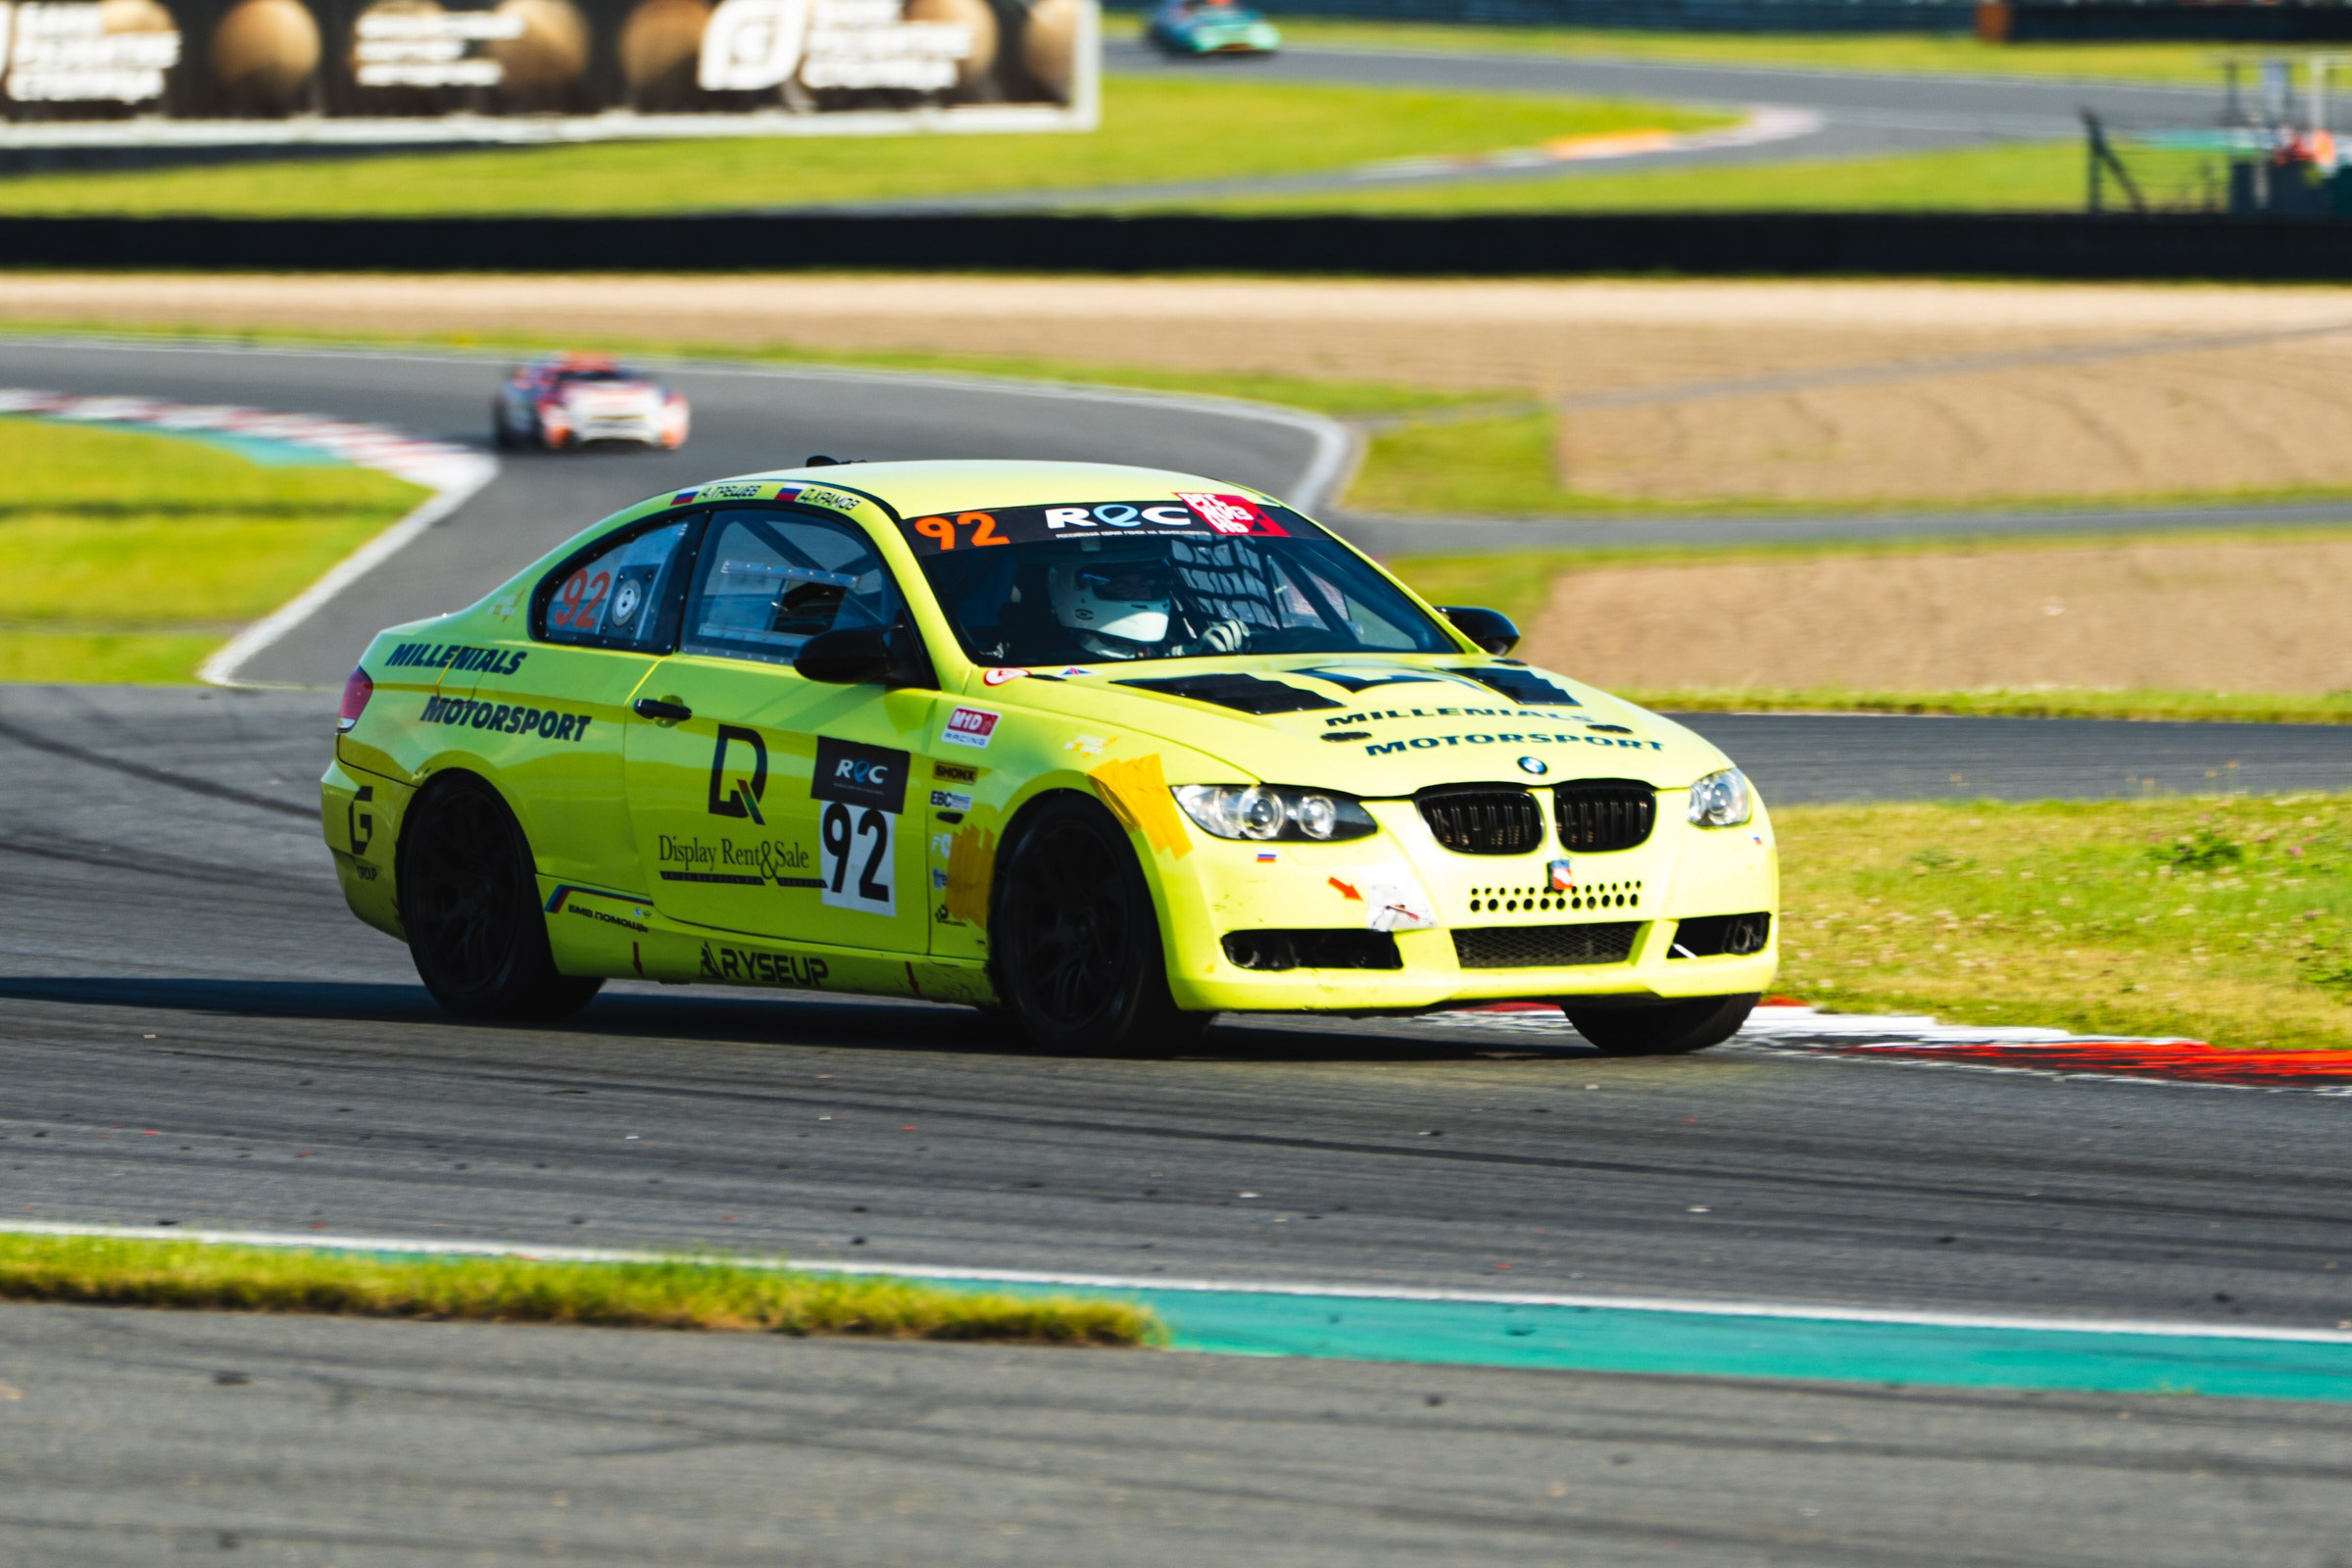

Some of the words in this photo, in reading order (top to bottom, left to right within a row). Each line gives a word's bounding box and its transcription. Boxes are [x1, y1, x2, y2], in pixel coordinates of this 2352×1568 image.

[914, 512, 1011, 551] 92
[556, 569, 611, 628] 92
[384, 643, 528, 675] MILLENIALS
[419, 697, 592, 742] MOTORSPORT
[1324, 707, 1595, 727] MILLENIALS
[1365, 732, 1664, 758] MOTORSPORT
[930, 790, 952, 808] EBC
[349, 786, 373, 856] G
[659, 834, 716, 871] Display
[822, 802, 890, 903] 92
[567, 904, 593, 918] БМВ
[594, 911, 649, 932] ПОМОЩЬ
